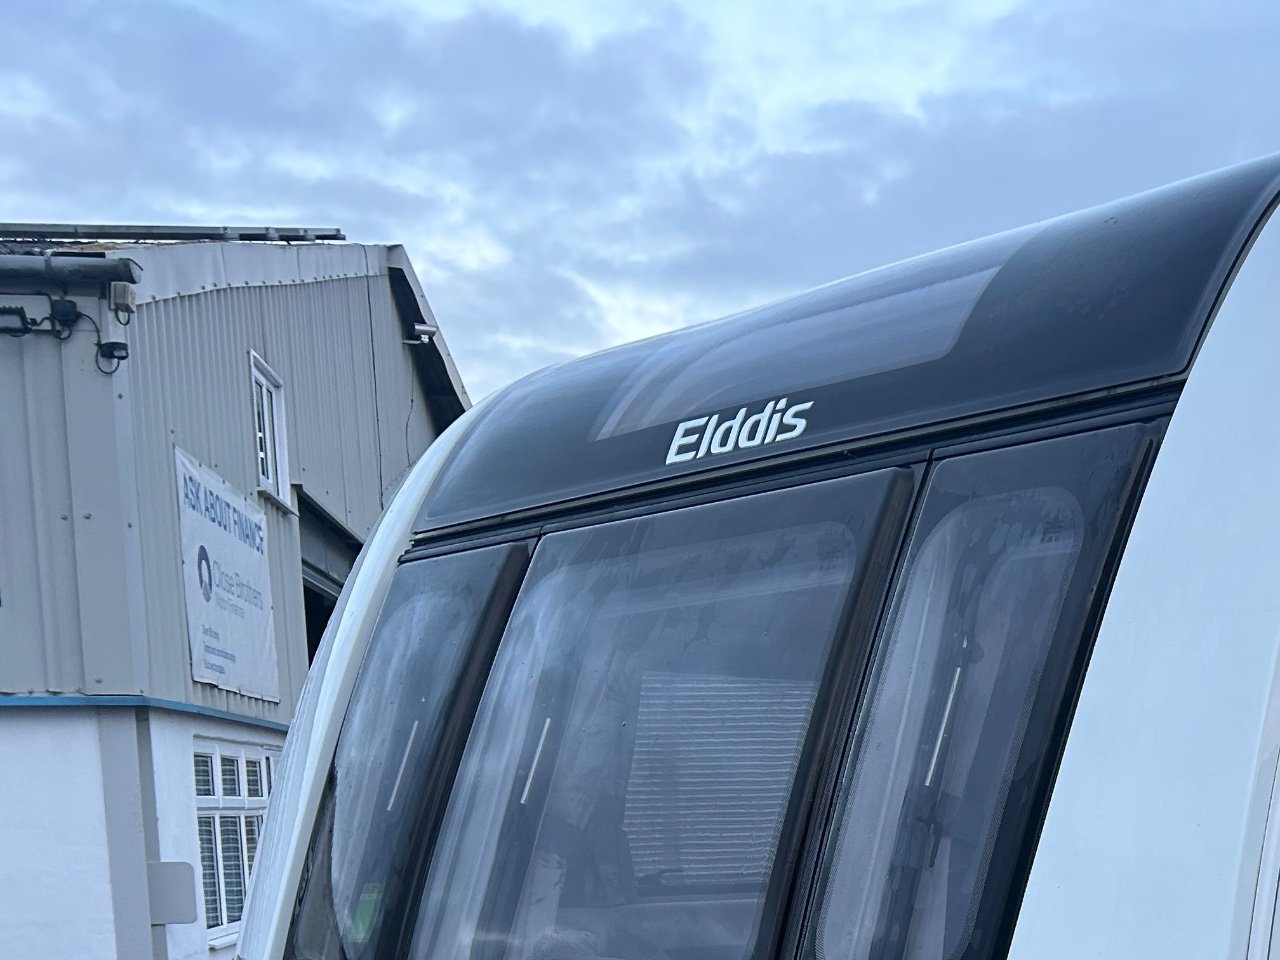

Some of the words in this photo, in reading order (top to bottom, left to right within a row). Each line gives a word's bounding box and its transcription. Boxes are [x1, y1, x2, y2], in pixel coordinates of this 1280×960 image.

[665, 397, 815, 465] Elddis
[183, 473, 203, 516] ASK
[203, 486, 231, 535] ABOUT
[232, 505, 264, 556] FINANCE
[212, 560, 235, 597] Close
